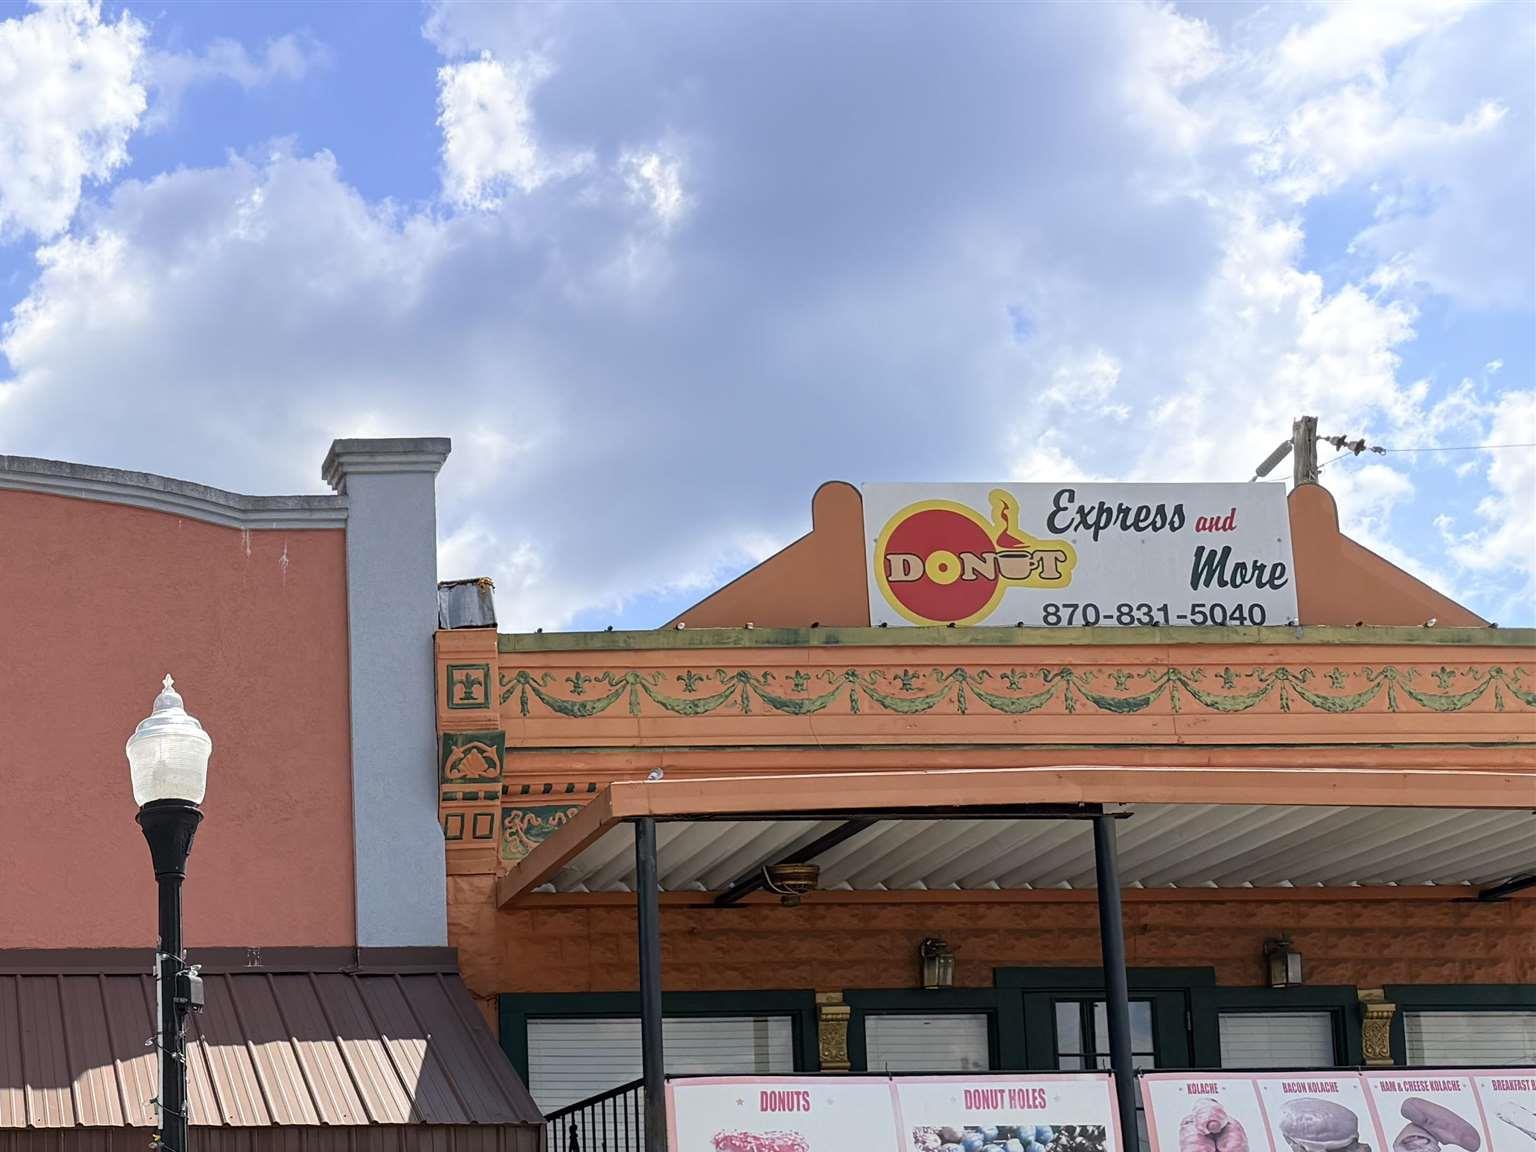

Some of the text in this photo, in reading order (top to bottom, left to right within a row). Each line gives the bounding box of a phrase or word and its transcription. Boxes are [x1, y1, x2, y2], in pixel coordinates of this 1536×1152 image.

[1047, 488, 1237, 542] Express and
[1190, 545, 1289, 591] More
[1042, 603, 1267, 626] 870-831-5040
[1187, 1083, 1219, 1094] KOLACHE
[1282, 1081, 1339, 1094] BACON KOLACHE
[1379, 1080, 1461, 1092] HAM & CHEESE KOLACHE
[1492, 1080, 1531, 1091] BREAKFAST
[760, 1091, 811, 1112] DONUTS
[964, 1088, 1047, 1111] DONUT HOLES
